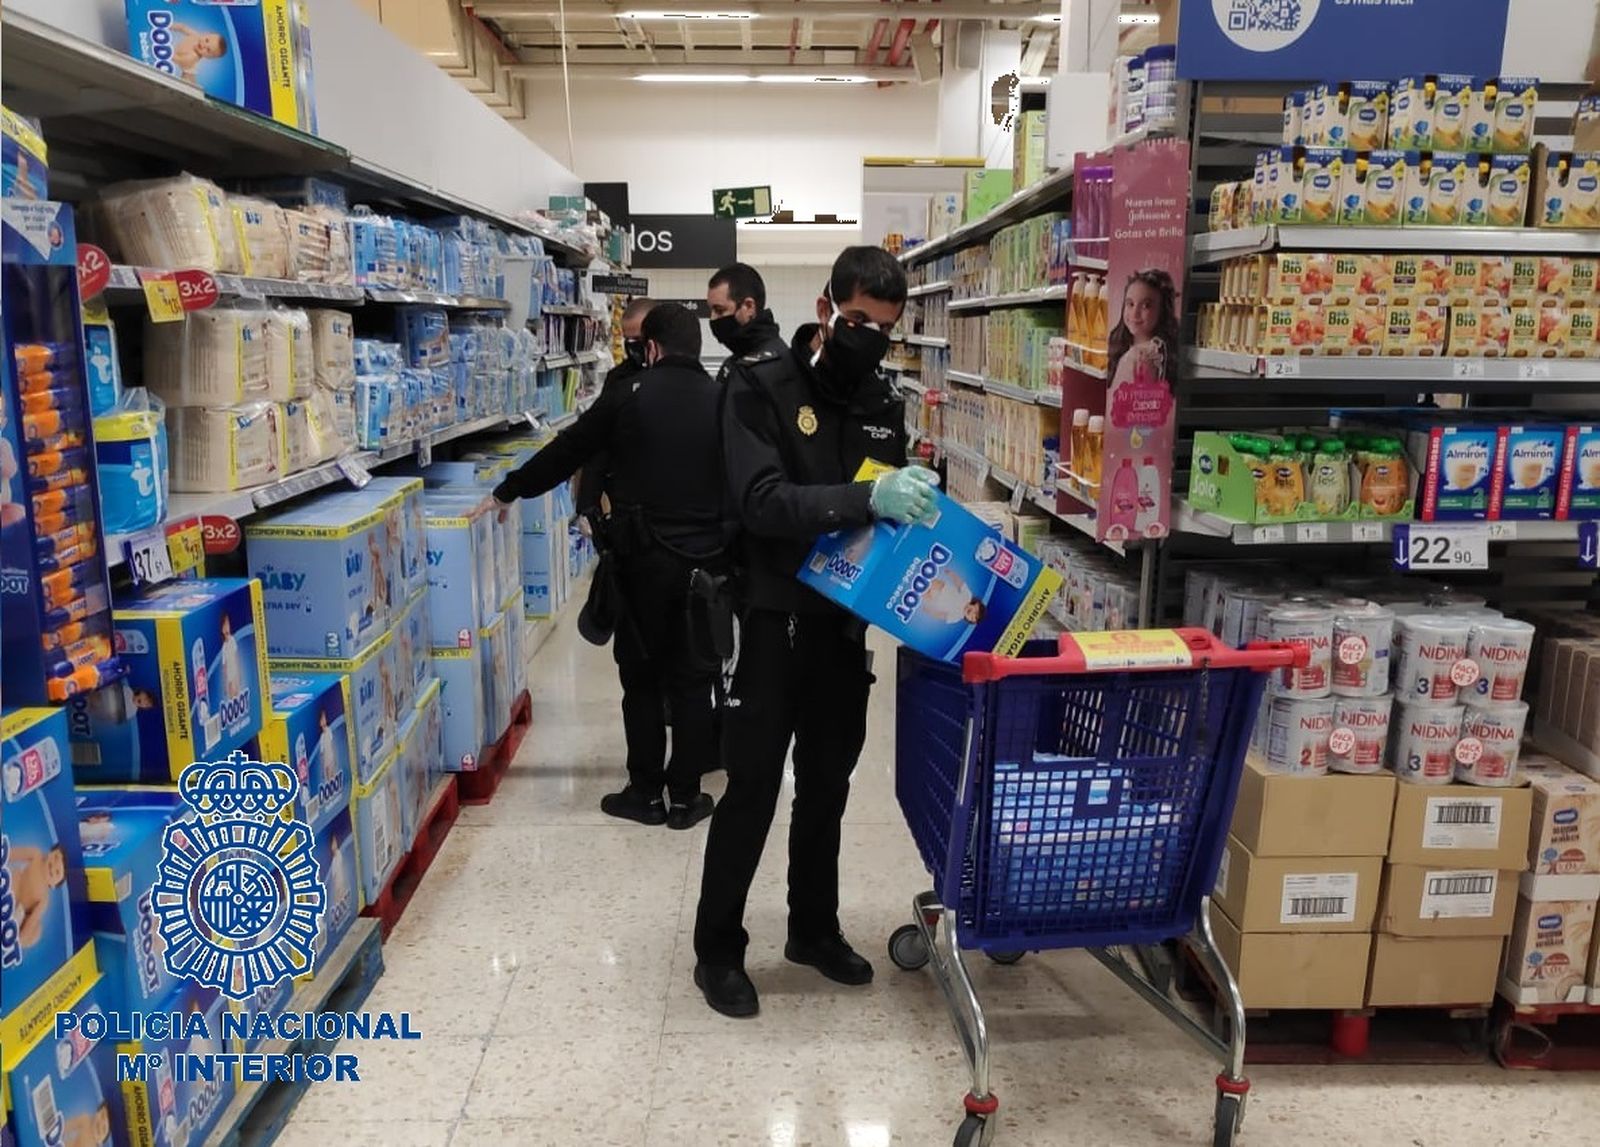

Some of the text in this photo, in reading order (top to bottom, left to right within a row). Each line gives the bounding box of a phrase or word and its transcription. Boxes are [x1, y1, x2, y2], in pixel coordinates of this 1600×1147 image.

[1114, 229, 1142, 239] Gotas
[1144, 228, 1156, 237] de
[1282, 259, 1302, 274] Bio
[1336, 260, 1357, 275] Bio
[1395, 260, 1416, 276] Bio
[1454, 262, 1476, 277] Bio
[1514, 262, 1534, 278] Bio
[1572, 264, 1593, 278] Bio
[178, 278, 216, 298] 3x2
[1272, 310, 1292, 326] Bio
[1328, 310, 1350, 326] Bio
[1390, 312, 1411, 326] Bio
[1456, 312, 1476, 327] Bio
[1514, 314, 1535, 328] Bio
[1572, 313, 1593, 328] Bio
[1447, 448, 1488, 459] Almirón
[1513, 448, 1554, 458] Almirón
[204, 523, 236, 538] 3x2
[1412, 536, 1450, 564] 22
[1454, 552, 1472, 564] 90
[134, 548, 152, 582] 37
[827, 554, 864, 580] DODOT
[895, 542, 953, 624] DODOT
[1022, 588, 1050, 632] AHORRO
[326, 632, 339, 648] 3
[1418, 678, 1428, 694] 3
[1476, 678, 1488, 694] 3
[172, 662, 189, 740] AHORRO GIGANTE
[220, 689, 250, 730] DODOT
[1300, 748, 1312, 766] 2
[1408, 756, 1420, 772] 3
[318, 771, 344, 806] DODOT
